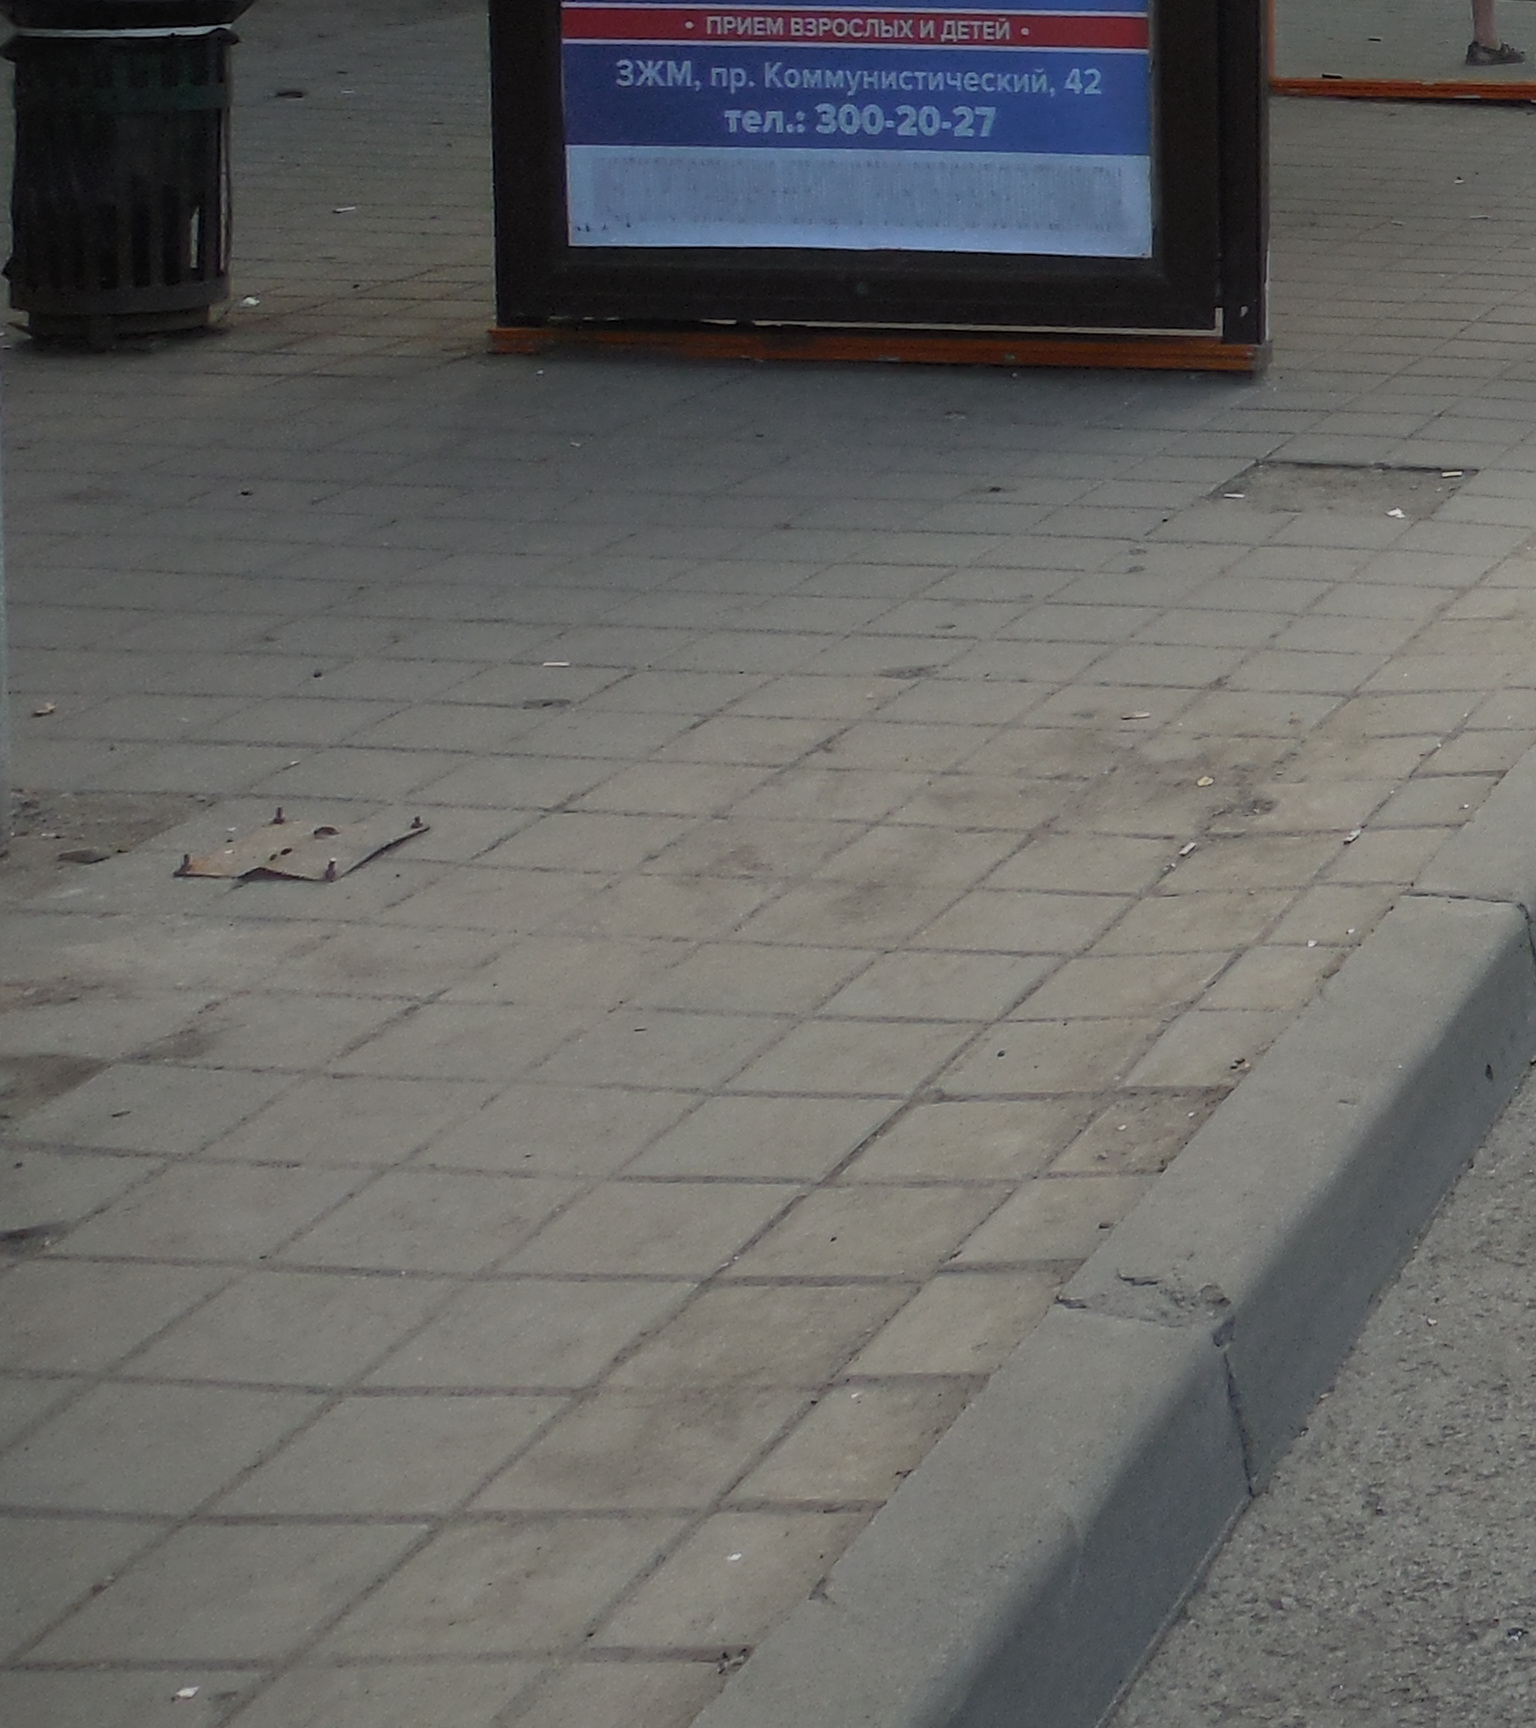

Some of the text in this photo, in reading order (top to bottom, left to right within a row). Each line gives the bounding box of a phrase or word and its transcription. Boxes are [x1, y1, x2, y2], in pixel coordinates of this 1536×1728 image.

[705, 16, 1011, 42] ПРИЕМ ВЗРОСЛЫХ И ДЕТЕЙ
[614, 59, 1103, 98] ЗЖМ, пр. Коммунистический, 42
[724, 103, 998, 138] тел.: 300-20-27
